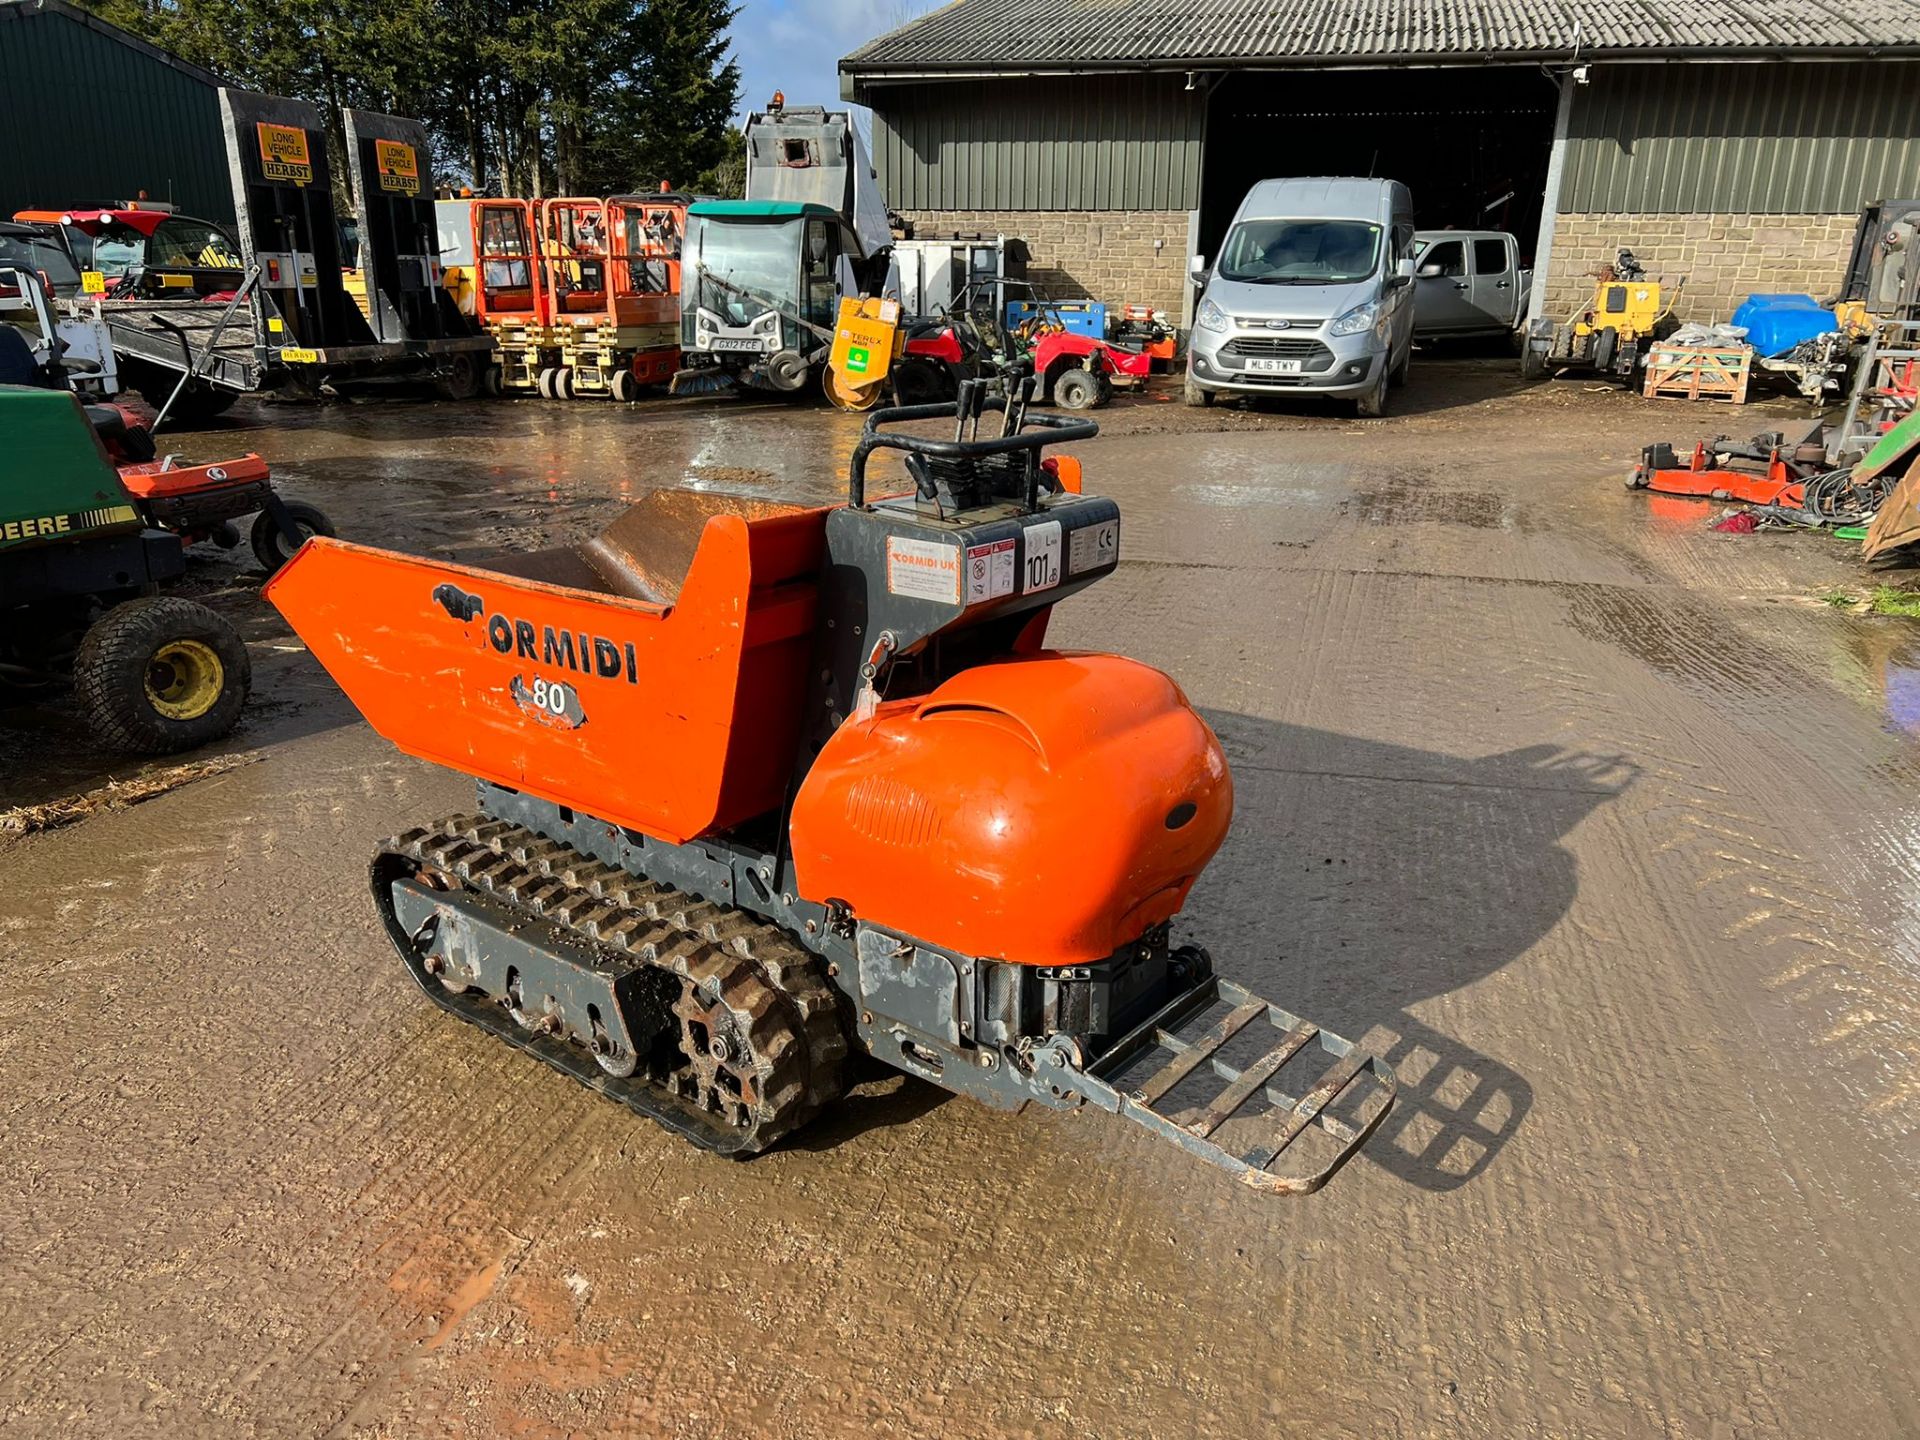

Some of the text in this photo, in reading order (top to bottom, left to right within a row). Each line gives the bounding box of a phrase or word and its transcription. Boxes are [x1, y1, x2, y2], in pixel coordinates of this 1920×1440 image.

[271, 132, 295, 144] LONG
[268, 144, 302, 156] VEHICLE
[386, 147, 406, 158] LONG
[384, 157, 412, 169] VEHICLE
[266, 163, 309, 178] HERBST
[383, 175, 417, 189] HERBST
[739, 340, 758, 349] FCE
[283, 351, 313, 359] HERBST
[1251, 360, 1295, 371] ML16 TWY
[0, 514, 71, 540] EERE
[940, 560, 955, 571] UK
[1027, 553, 1048, 589] 101
[464, 602, 638, 684] ORMIDI
[533, 679, 566, 715] 80
